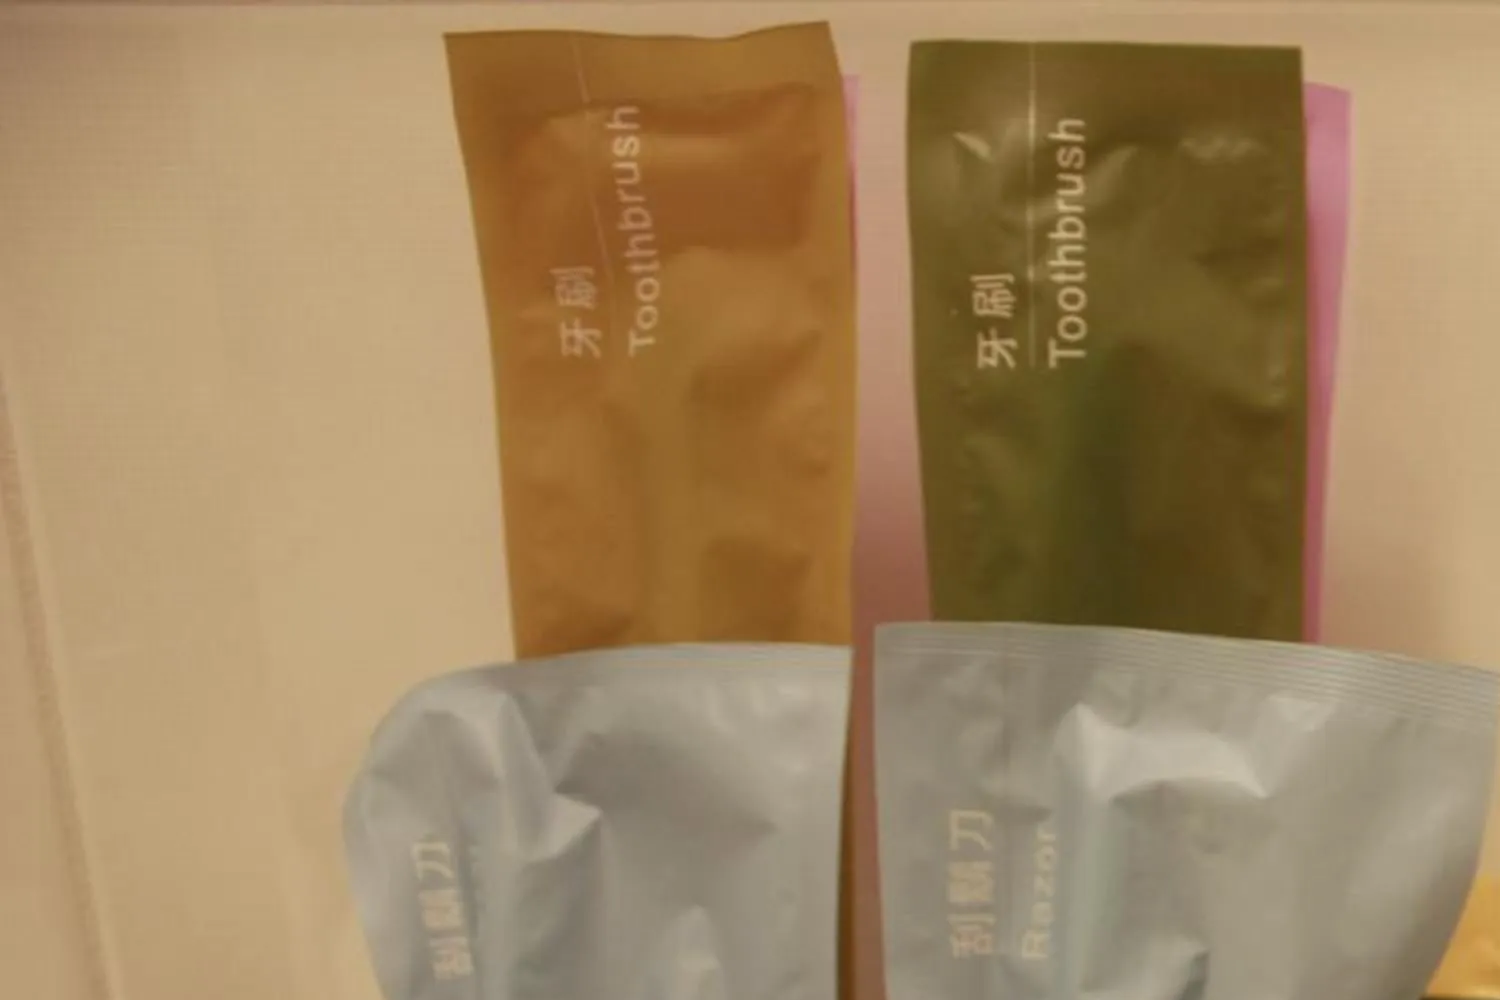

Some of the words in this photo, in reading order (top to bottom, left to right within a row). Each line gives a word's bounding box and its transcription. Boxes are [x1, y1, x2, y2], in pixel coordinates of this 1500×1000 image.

[604, 105, 661, 358] Toothbrush
[1047, 117, 1088, 369] Toothbrush
[550, 266, 602, 359] 牙刷
[969, 273, 1018, 370] 牙刷
[1021, 821, 1056, 960] Razor
